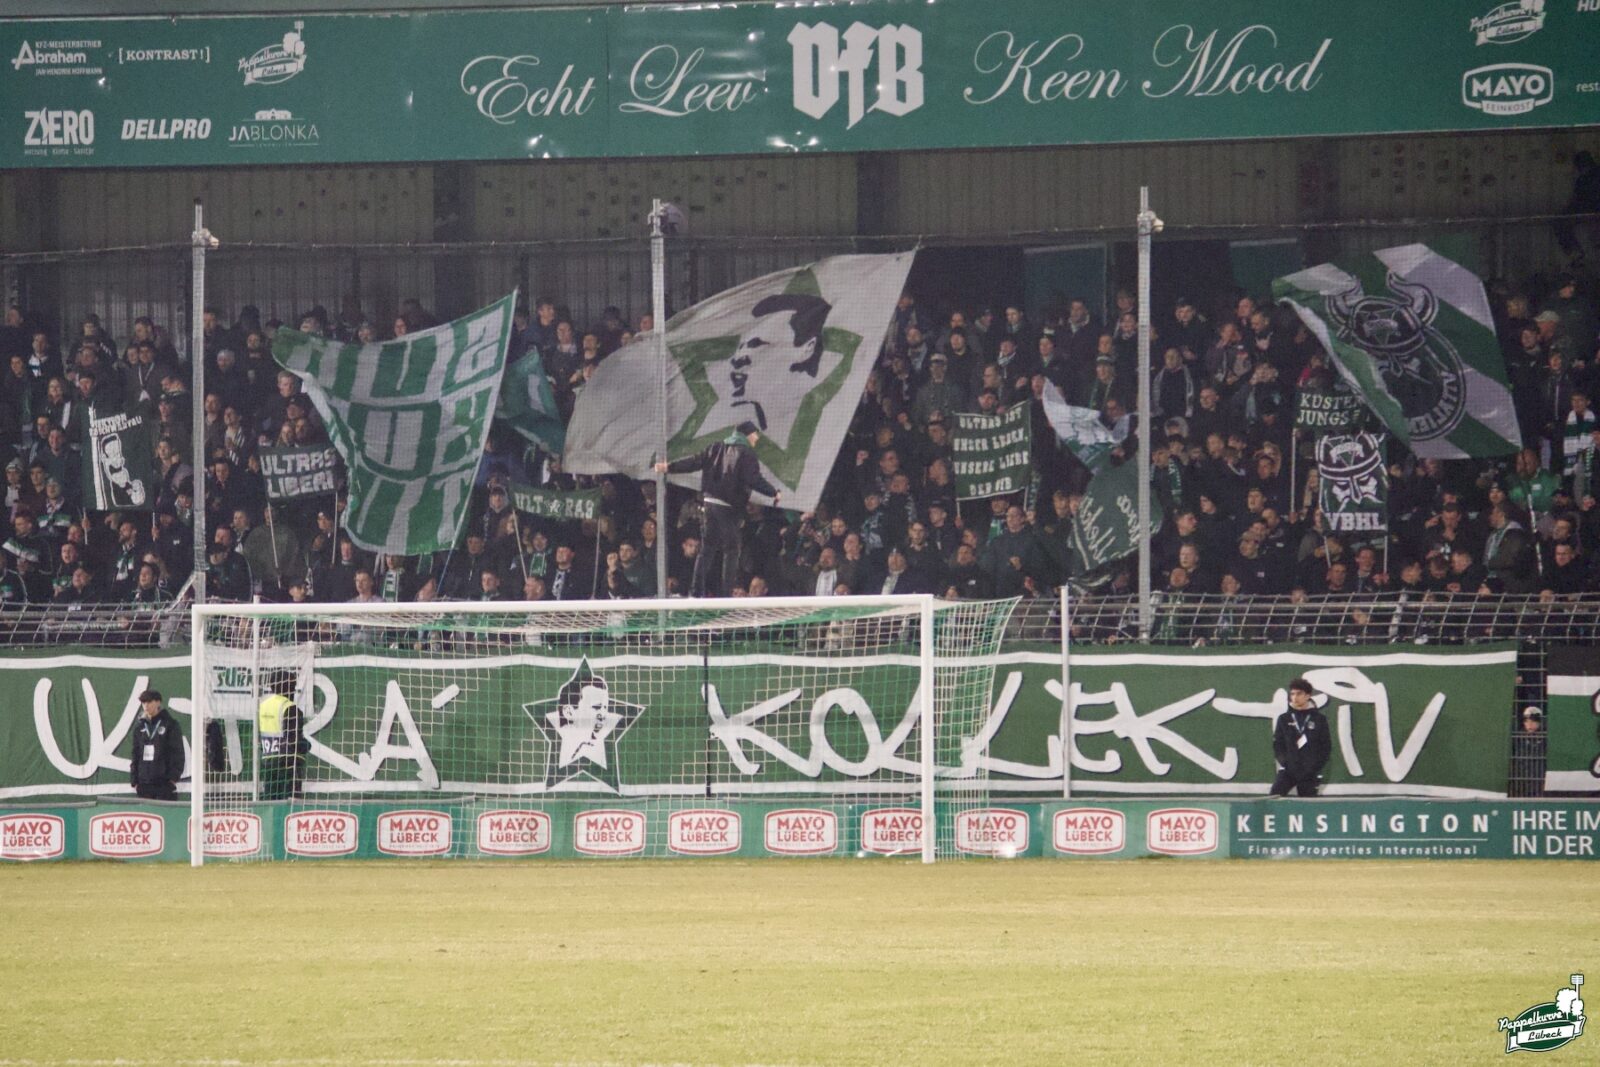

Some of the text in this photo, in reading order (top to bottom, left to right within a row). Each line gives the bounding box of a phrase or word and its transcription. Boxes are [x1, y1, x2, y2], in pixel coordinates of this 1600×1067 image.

[460, 54, 596, 125] Echt
[618, 44, 756, 117] Leev
[963, 31, 1128, 104] Keen
[1141, 23, 1333, 99] Mood
[1471, 75, 1545, 97] MAYO
[1485, 101, 1531, 112] FEINKOST
[121, 117, 212, 140] DELLPRO
[228, 124, 320, 142] JABLONKA
[260, 448, 336, 475] ULTRAS
[1324, 512, 1388, 531] VBHL
[102, 820, 152, 834] MAYO
[297, 818, 346, 832] MAYO
[390, 818, 439, 831] MAYO
[490, 818, 539, 831] MAYO
[586, 817, 633, 830] MAYO
[680, 817, 728, 830] MAYO
[777, 817, 825, 830] MAYO
[968, 816, 1016, 830] MAYO
[1066, 816, 1113, 829] MAYO
[1160, 816, 1206, 830] MAYO
[1237, 814, 1490, 833] KENSINGTON
[1512, 810, 1568, 831] IHRE
[3, 820, 52, 835] MAYO
[3, 835, 51, 847] LÜBECK
[102, 834, 151, 845] LÜBECK
[297, 832, 345, 843] LÜBECK
[390, 831, 438, 843] LÜBECK
[490, 831, 538, 843] LÜBECK
[586, 830, 632, 842] LÜBECK
[680, 830, 727, 842] LÜBECK
[777, 830, 824, 842] LÜBECK
[968, 830, 1015, 842] LÜBECK
[1066, 829, 1112, 841] LÜBECK
[1160, 830, 1205, 842] LÜBECK
[1249, 845, 1477, 857] Finest Properties International
[1513, 835, 1594, 855] IN DER
